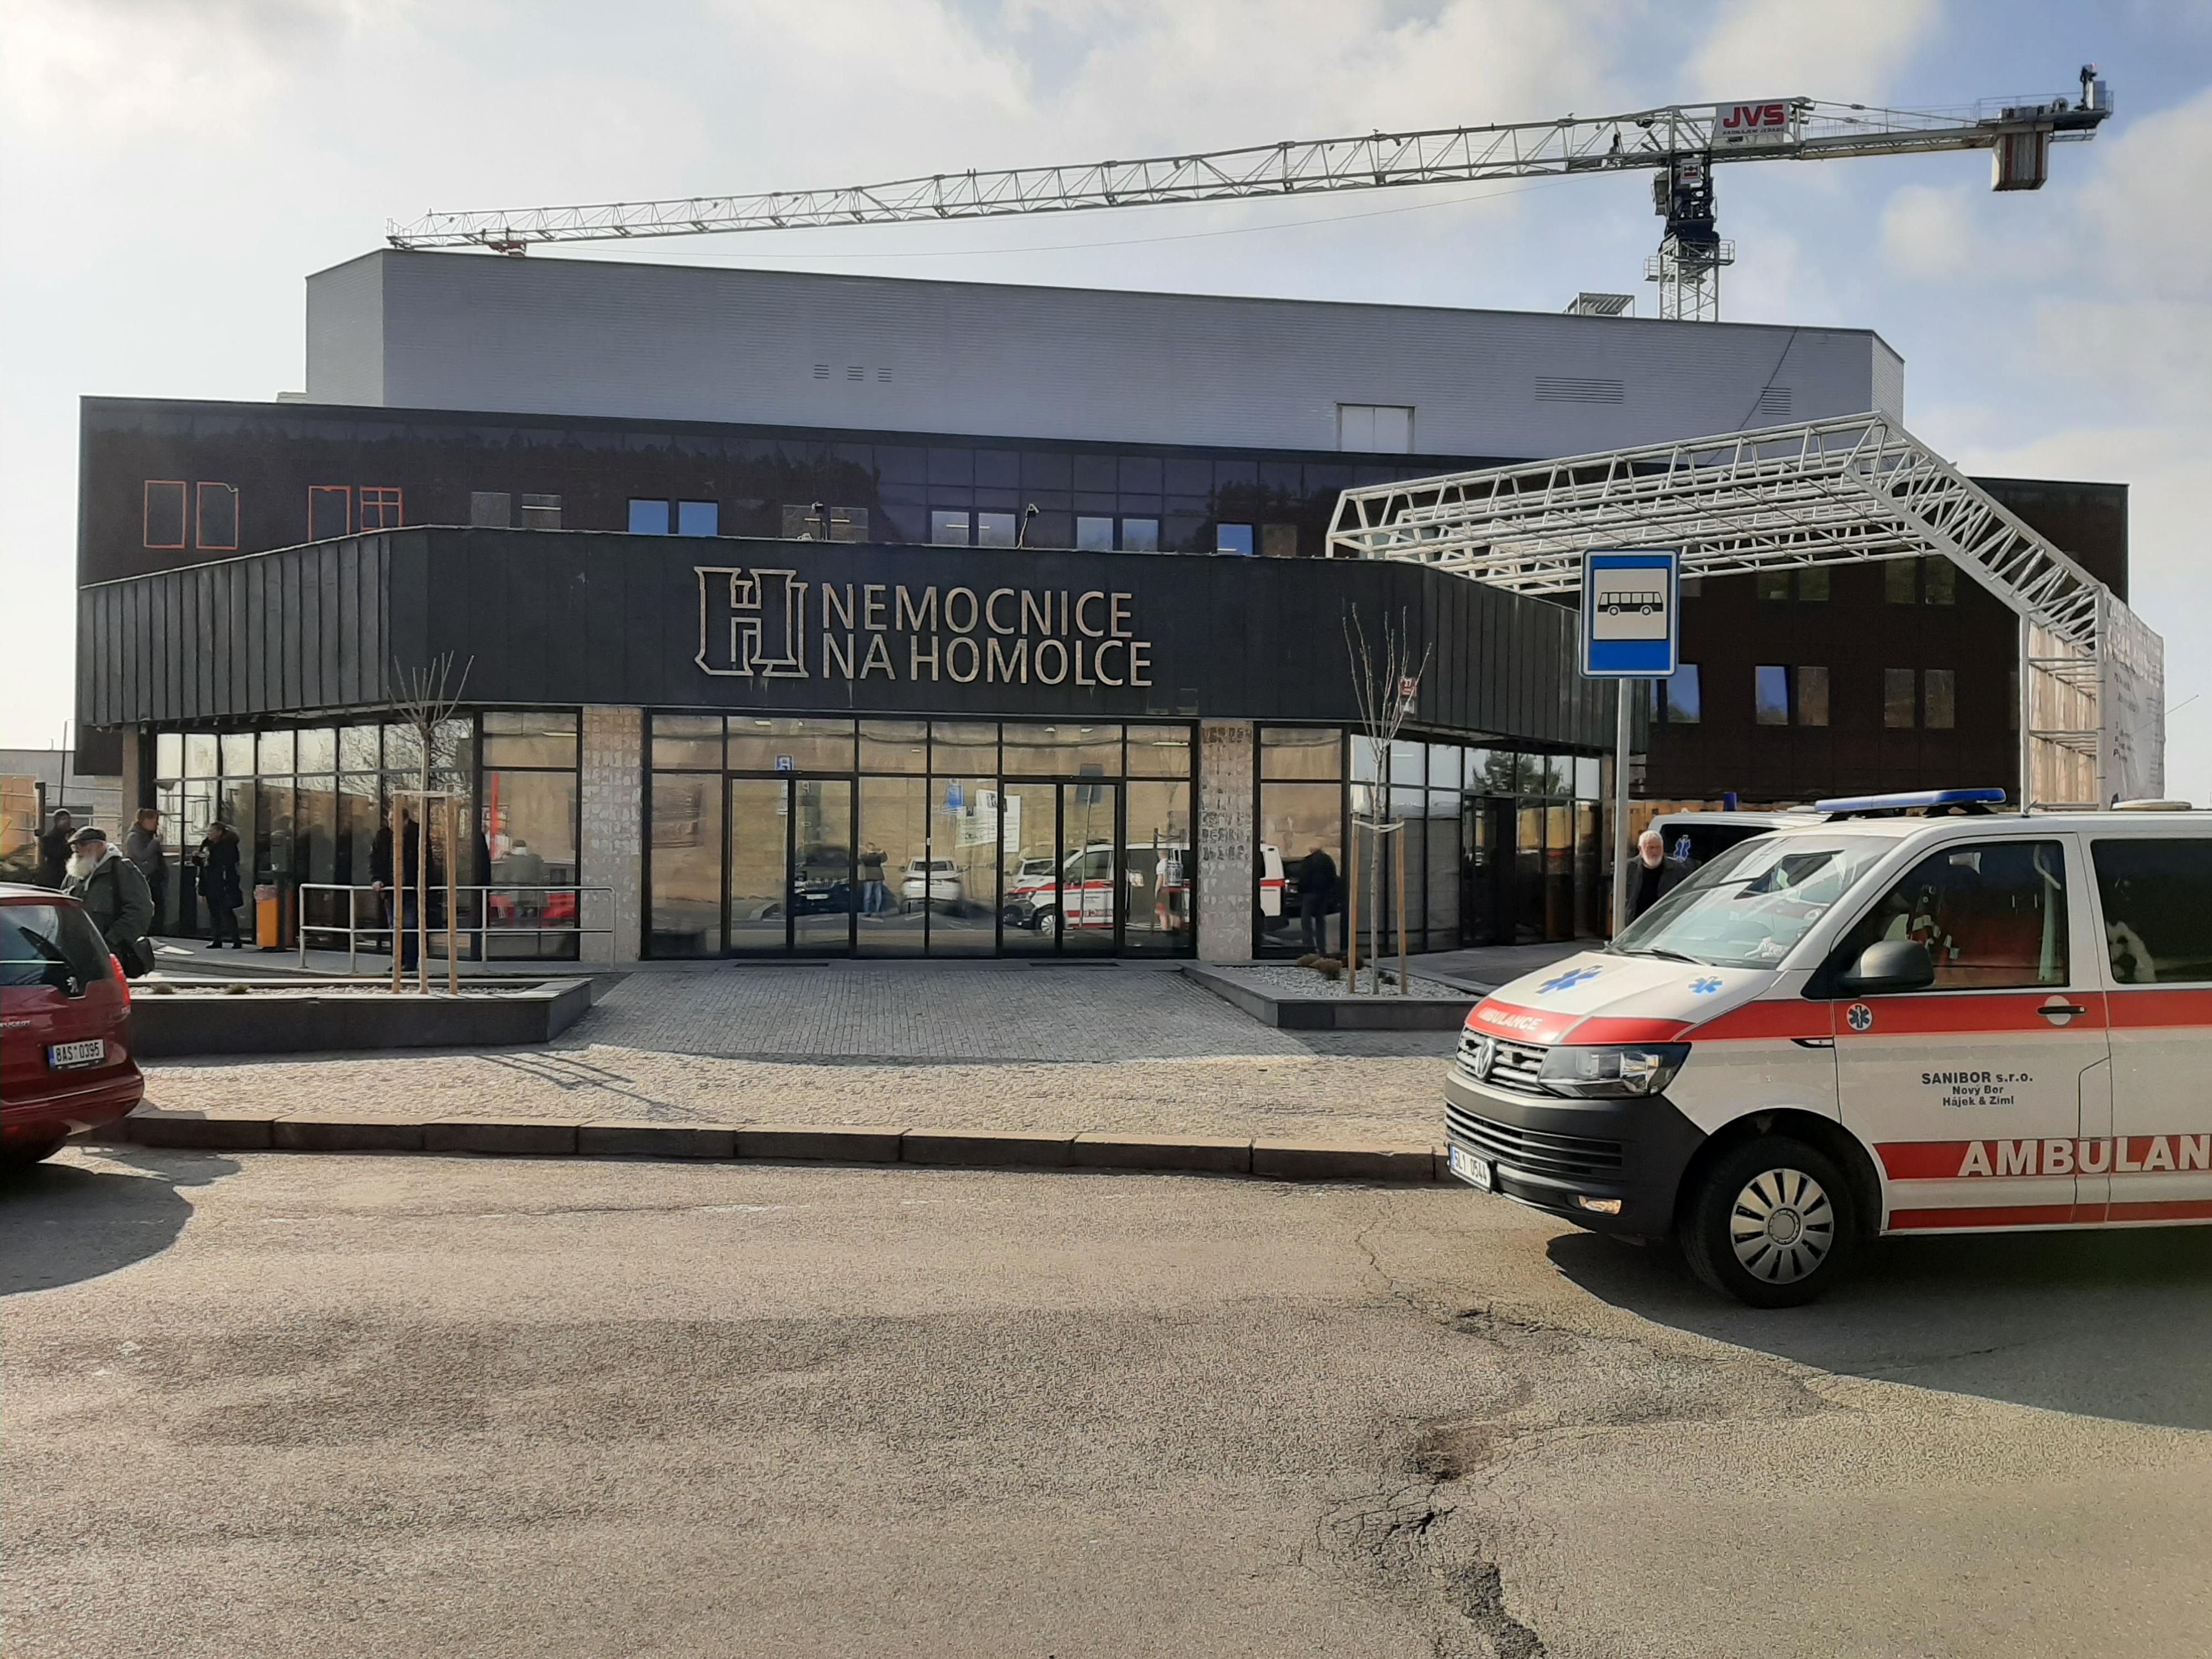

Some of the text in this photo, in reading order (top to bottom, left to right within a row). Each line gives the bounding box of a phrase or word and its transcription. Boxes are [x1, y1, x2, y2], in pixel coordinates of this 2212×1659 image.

[1723, 104, 1785, 128] JVS
[822, 582, 1133, 638] NEMOCNICE
[822, 632, 1152, 687] NA HOMOLCE
[56, 1042, 100, 1062] 8AS 0395
[1922, 1072, 2033, 1084] SANIBOR s.r.o.
[1952, 1084, 2004, 1095] Nový Bor
[1943, 1097, 1975, 1107] Hájek
[1979, 1096, 1986, 1105] &
[1958, 1133, 2211, 1177] AMBULAN
